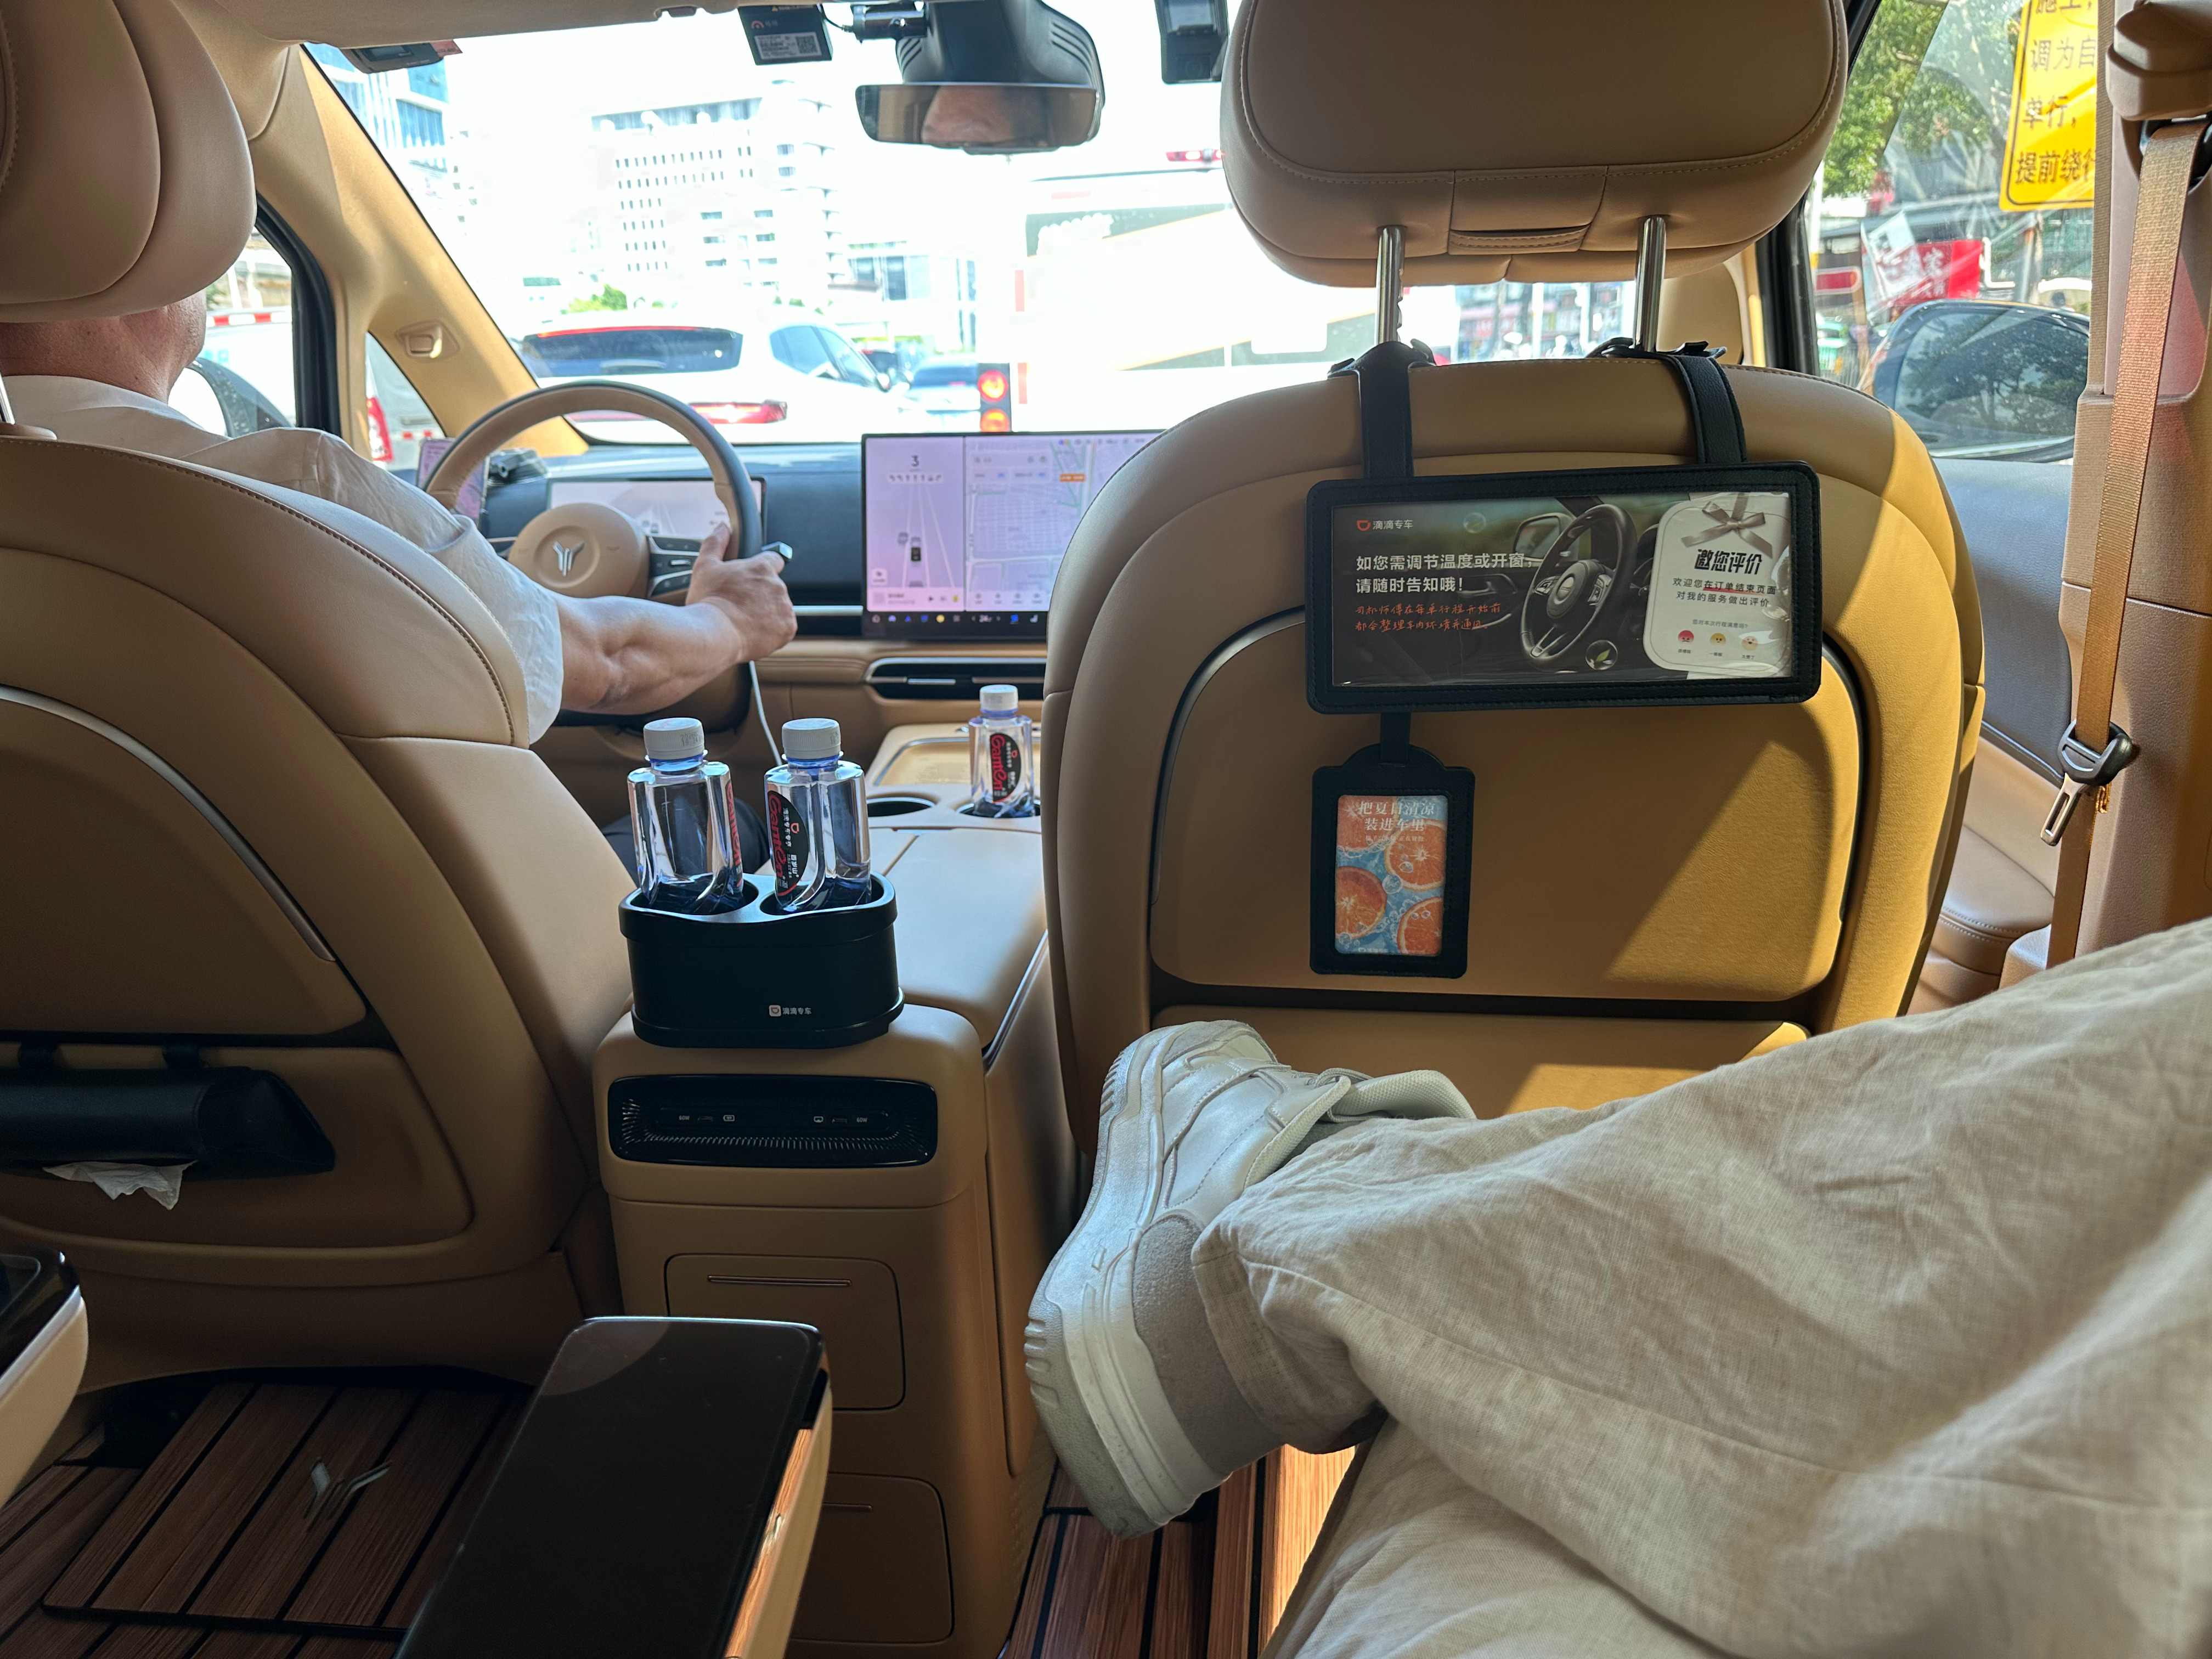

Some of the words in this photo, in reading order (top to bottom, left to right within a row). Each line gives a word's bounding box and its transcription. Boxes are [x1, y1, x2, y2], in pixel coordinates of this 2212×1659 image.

[1373, 520, 1413, 530] 滴滴专车
[1356, 552, 1533, 571] 如您需调节温度或开窗，
[1694, 549, 1762, 574] 邀您评价
[1356, 577, 1463, 594] 请随时告知哦！
[1673, 578, 1777, 595] 欢迎您在订单结束页面
[1676, 591, 1769, 607] 对我的服务做出评价
[1356, 602, 1502, 616] 司机师傅在每单行程开始前
[1359, 801, 1436, 815] 把夏日清凉
[1365, 818, 1425, 832] 装进车里
